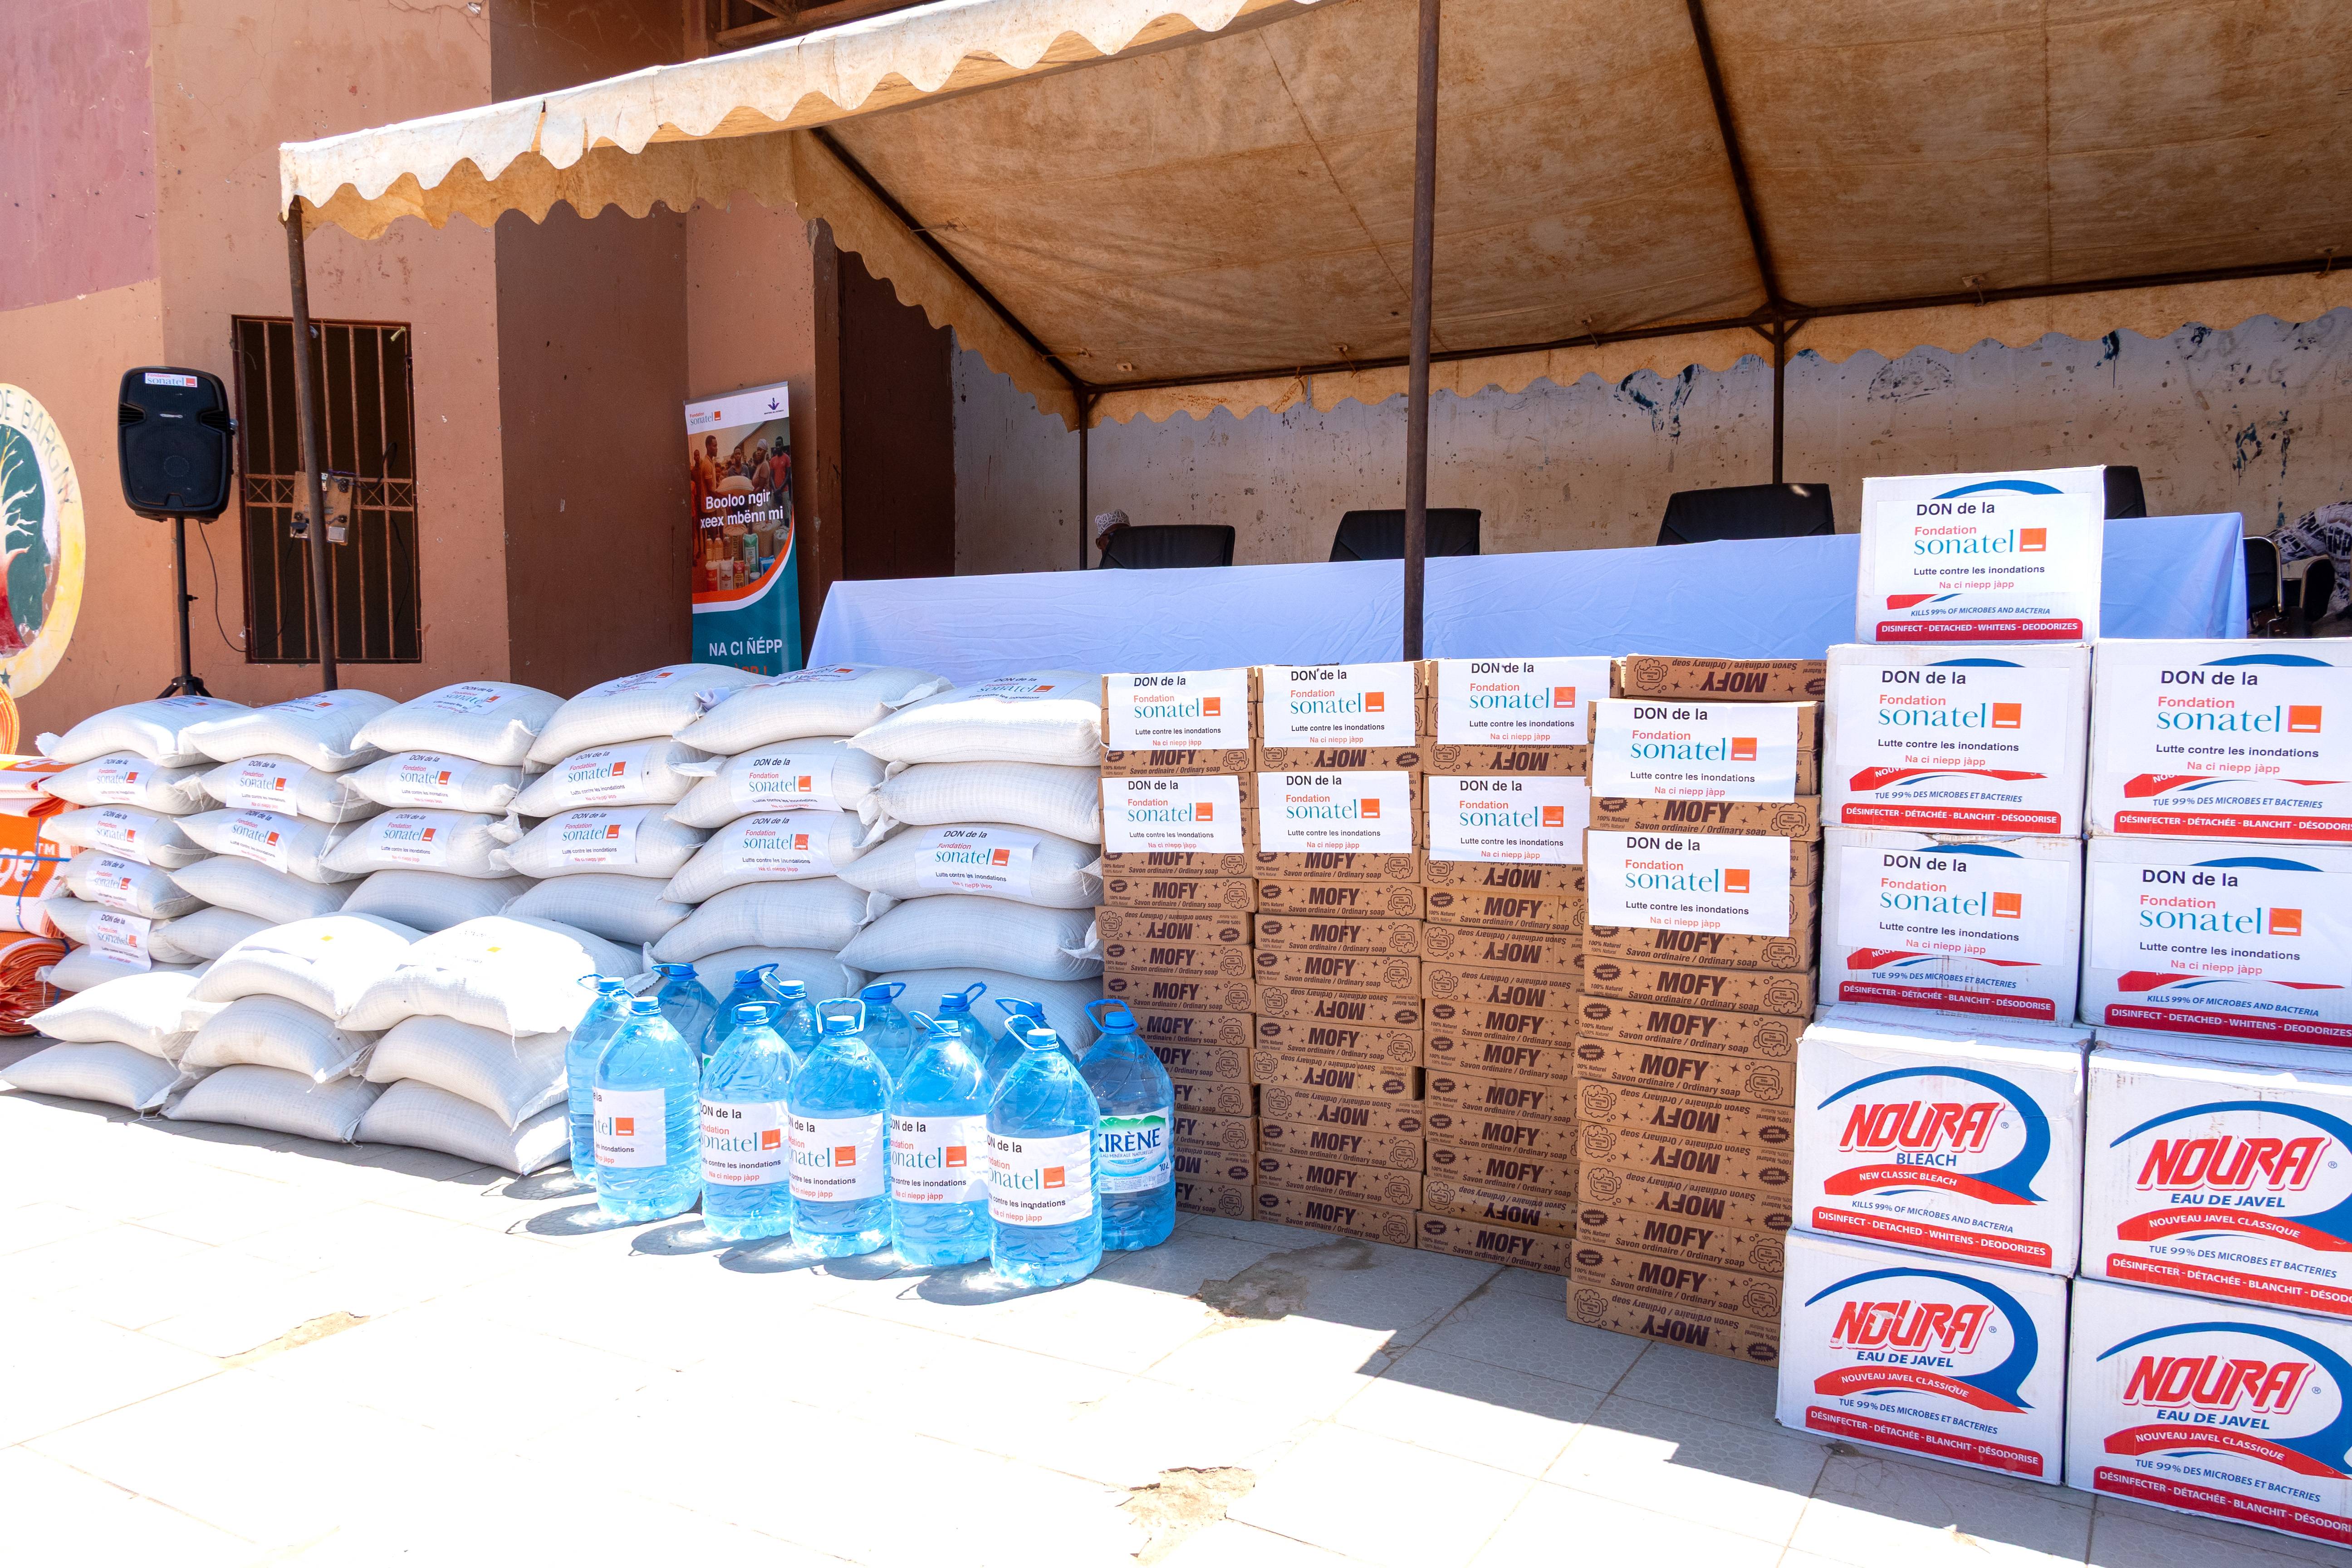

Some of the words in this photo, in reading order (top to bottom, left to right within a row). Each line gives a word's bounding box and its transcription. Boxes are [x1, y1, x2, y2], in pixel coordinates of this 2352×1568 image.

[690, 412, 713, 425] sonatel
[706, 494, 745, 510] Booloo
[749, 489, 770, 506] ngir
[1917, 504, 1951, 515] DON
[1958, 503, 1976, 514] de
[1982, 502, 1994, 513] la
[701, 516, 724, 529] xeex
[727, 510, 765, 525] mbënn
[769, 506, 783, 520] mi
[1915, 525, 1976, 535] Fondation
[1914, 529, 2013, 554] sonatel
[1965, 581, 1990, 589] niepp
[1994, 581, 2014, 589] jàpp
[2022, 622, 2078, 631] DEODORIZES
[709, 642, 727, 656] NA
[730, 641, 743, 656] CI
[747, 637, 783, 654] ÑÉPP
[1692, 660, 1726, 669] Ordinary
[1134, 677, 1157, 686] DON
[1161, 676, 1173, 686] de
[1177, 676, 1186, 685] la
[1700, 672, 1768, 692] MOFY
[1134, 698, 1199, 718] sonatel
[568, 763, 612, 782] sonatel
[1663, 800, 1735, 823] MOFY
[383, 828, 424, 840] sonatel
[1635, 822, 1659, 830] Savon
[1661, 824, 1698, 832] ordinaire
[1707, 826, 1744, 835] Ordinary
[743, 834, 793, 849] sonatel
[1627, 837, 1659, 849] DON
[1666, 838, 1682, 850] de
[1689, 839, 1700, 850] la
[936, 848, 991, 864] sonatel
[1626, 860, 1683, 870] Fondation
[1626, 869, 1718, 892] sonatel
[1696, 905, 1749, 914] inondations
[1675, 918, 1698, 927] niepp
[1701, 920, 1720, 929] jàpp
[716, 1108, 728, 1118] de
[732, 1109, 741, 1118] la
[1838, 1100, 2005, 1153] NOURA
[740, 1160, 780, 1168] inondations
[1896, 1153, 1957, 1166] BLEACH
[1860, 1172, 1879, 1180] NEW
[1919, 1173, 1957, 1186] BLEACH
[1907, 1207, 1950, 1220] MICROBES
[1951, 1215, 1970, 1224] AND
[1972, 1220, 2013, 1233] BACTERIA
[1818, 1211, 1866, 1225] DISINFECT
[1873, 1220, 1922, 1235] DETACHED
[1930, 1230, 1973, 1244] WHITENS
[1980, 1238, 2046, 1256] DEODORIZES
[1828, 1300, 1994, 1353] NOURA
[1857, 1351, 1885, 1362] EAU
[1888, 1354, 1908, 1363] DE
[1911, 1356, 1953, 1367] JAVEL
[1842, 1373, 1885, 1383] NOUVEAU
[1887, 1373, 1913, 1382] JAVEL
[1915, 1376, 1970, 1398] CLASSIQUE
[1839, 1398, 1854, 1406] TUE
[1857, 1401, 1878, 1410] 99%
[1880, 1404, 1895, 1412] DES
[1897, 1407, 1939, 1420] MICROBES
[1953, 1418, 1998, 1434] BACTERIES
[1811, 1410, 1868, 1430] DÉSINFECTER
[1874, 1425, 1919, 1440] DÉTACHÉE
[1926, 1435, 1971, 1450] BLANCHIT
[1978, 1445, 2038, 1465] DÉSODORISE
